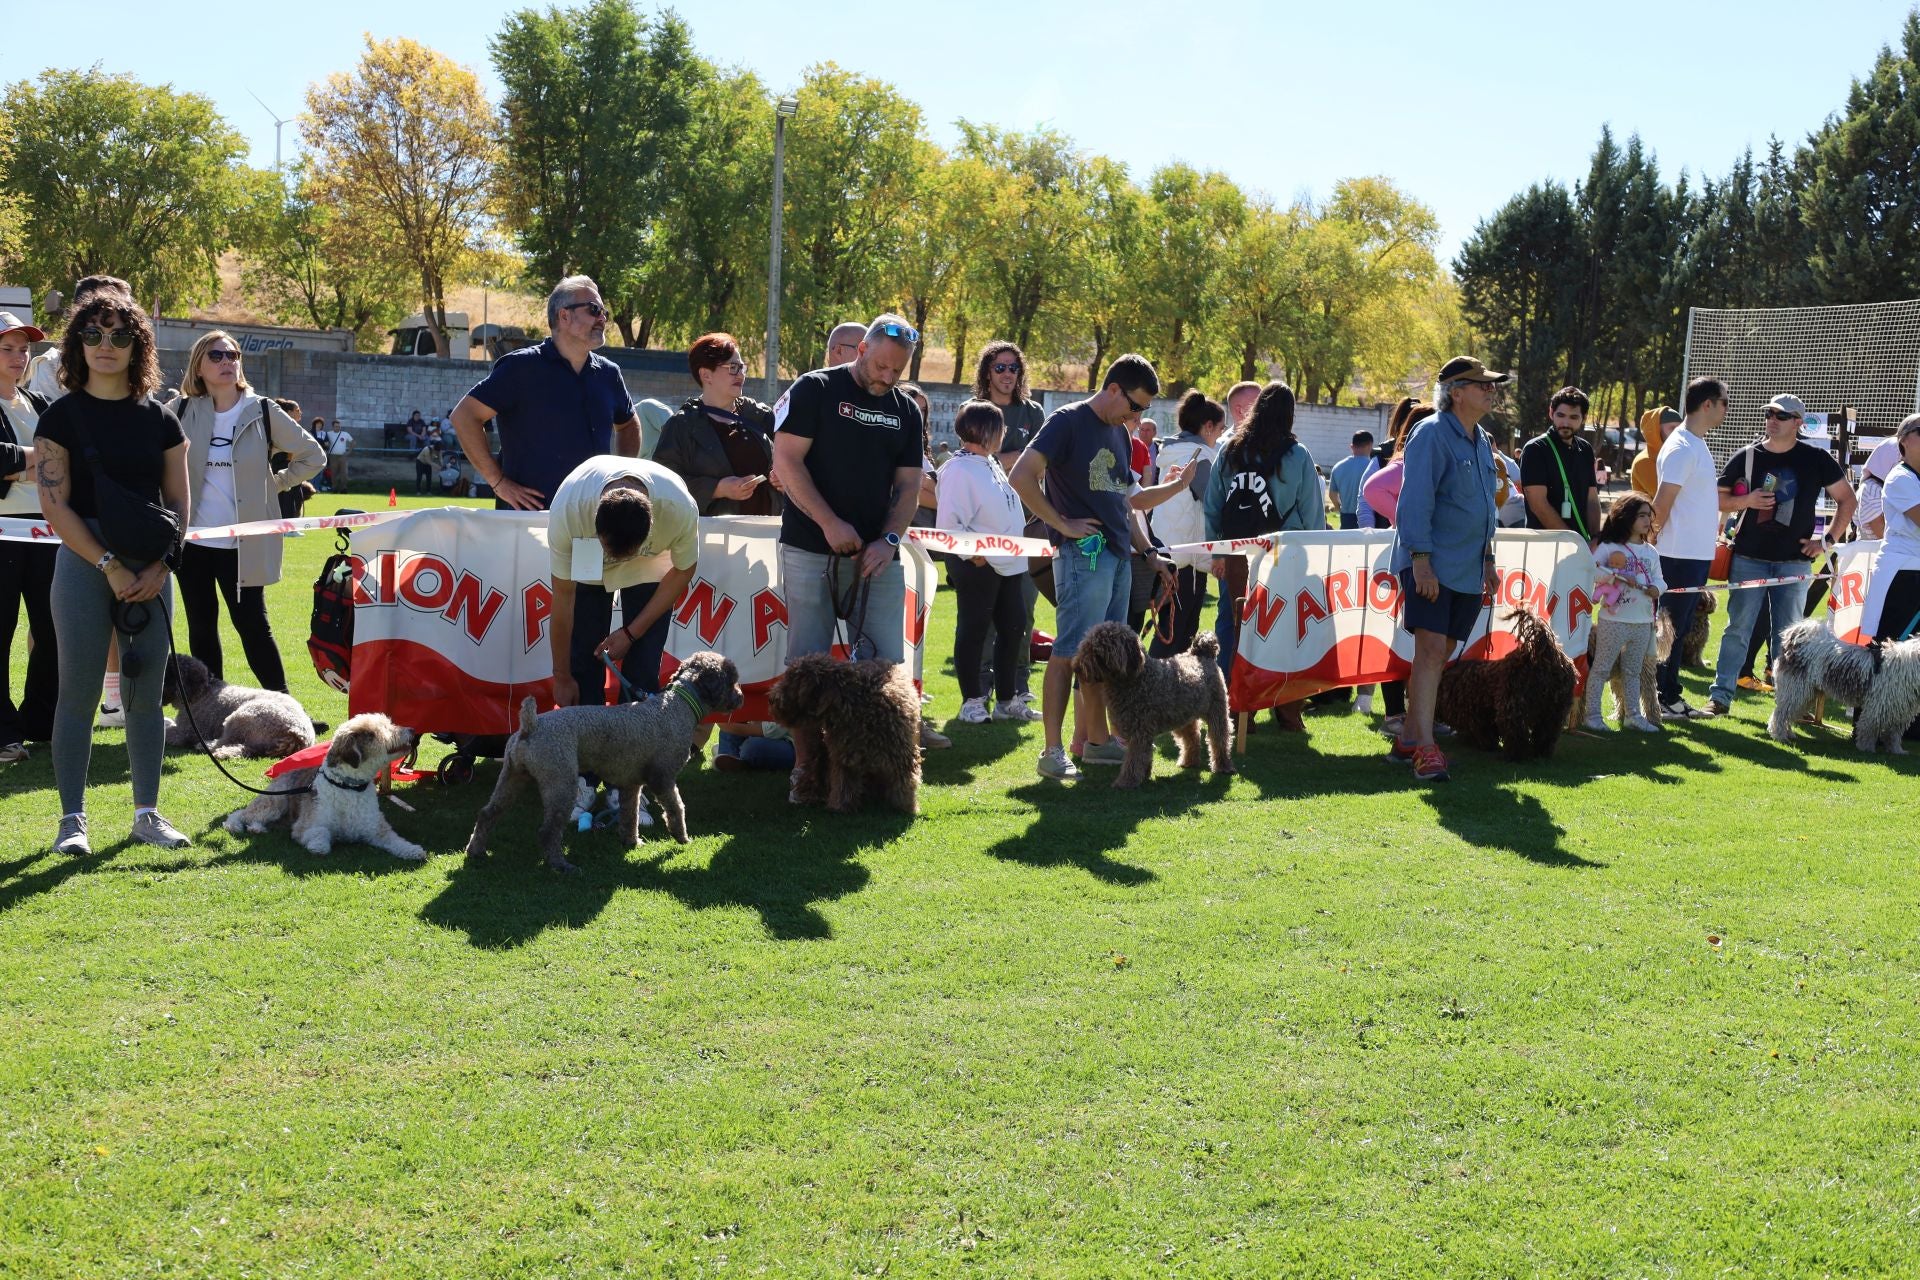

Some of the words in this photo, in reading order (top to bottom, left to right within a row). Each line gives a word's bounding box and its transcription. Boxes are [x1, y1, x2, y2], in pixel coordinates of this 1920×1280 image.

[854, 411, 898, 426] CONVERSE
[908, 530, 958, 550] ARION
[975, 537, 1024, 556] ARION
[1231, 538, 1273, 552] ARION
